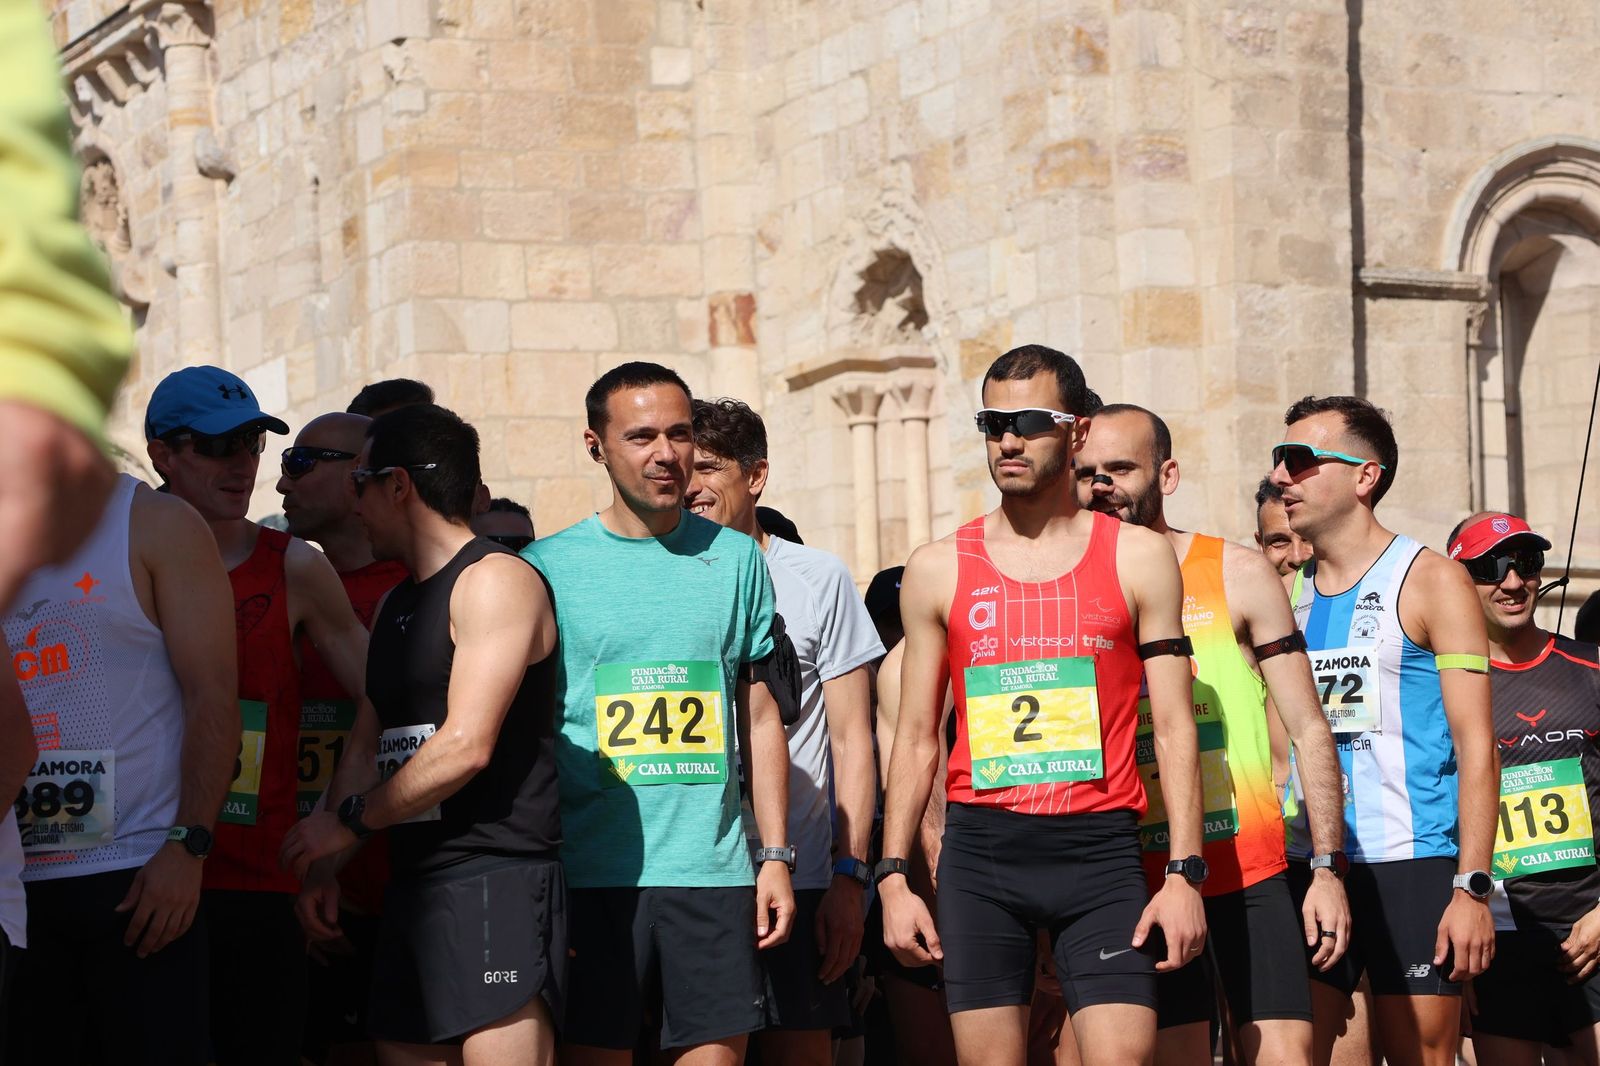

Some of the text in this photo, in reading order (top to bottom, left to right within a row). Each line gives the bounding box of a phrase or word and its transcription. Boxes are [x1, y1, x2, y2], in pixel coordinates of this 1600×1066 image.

[1009, 634, 1074, 647] vistasol
[1082, 634, 1114, 650] tribe
[1314, 656, 1371, 671] ZAMORA
[631, 675, 689, 685] CAJA RURAL
[1000, 672, 1060, 686] CAJA RURAL
[1318, 673, 1364, 705] 72
[1011, 695, 1043, 743] 2
[1330, 709, 1356, 719] ATLETISMO
[606, 696, 707, 748] 242
[638, 762, 720, 776] CAJA RURAL
[1008, 760, 1097, 776] CAJA RURAL
[1502, 775, 1555, 788] CAJA RURAL
[223, 802, 250, 815] RAL
[33, 822, 85, 834] CLUB ATLETISMO
[1204, 819, 1233, 833] RAL
[33, 834, 60, 845] ZAMORA
[1520, 847, 1591, 866] CAJA RURAL
[483, 970, 518, 984] GORE
